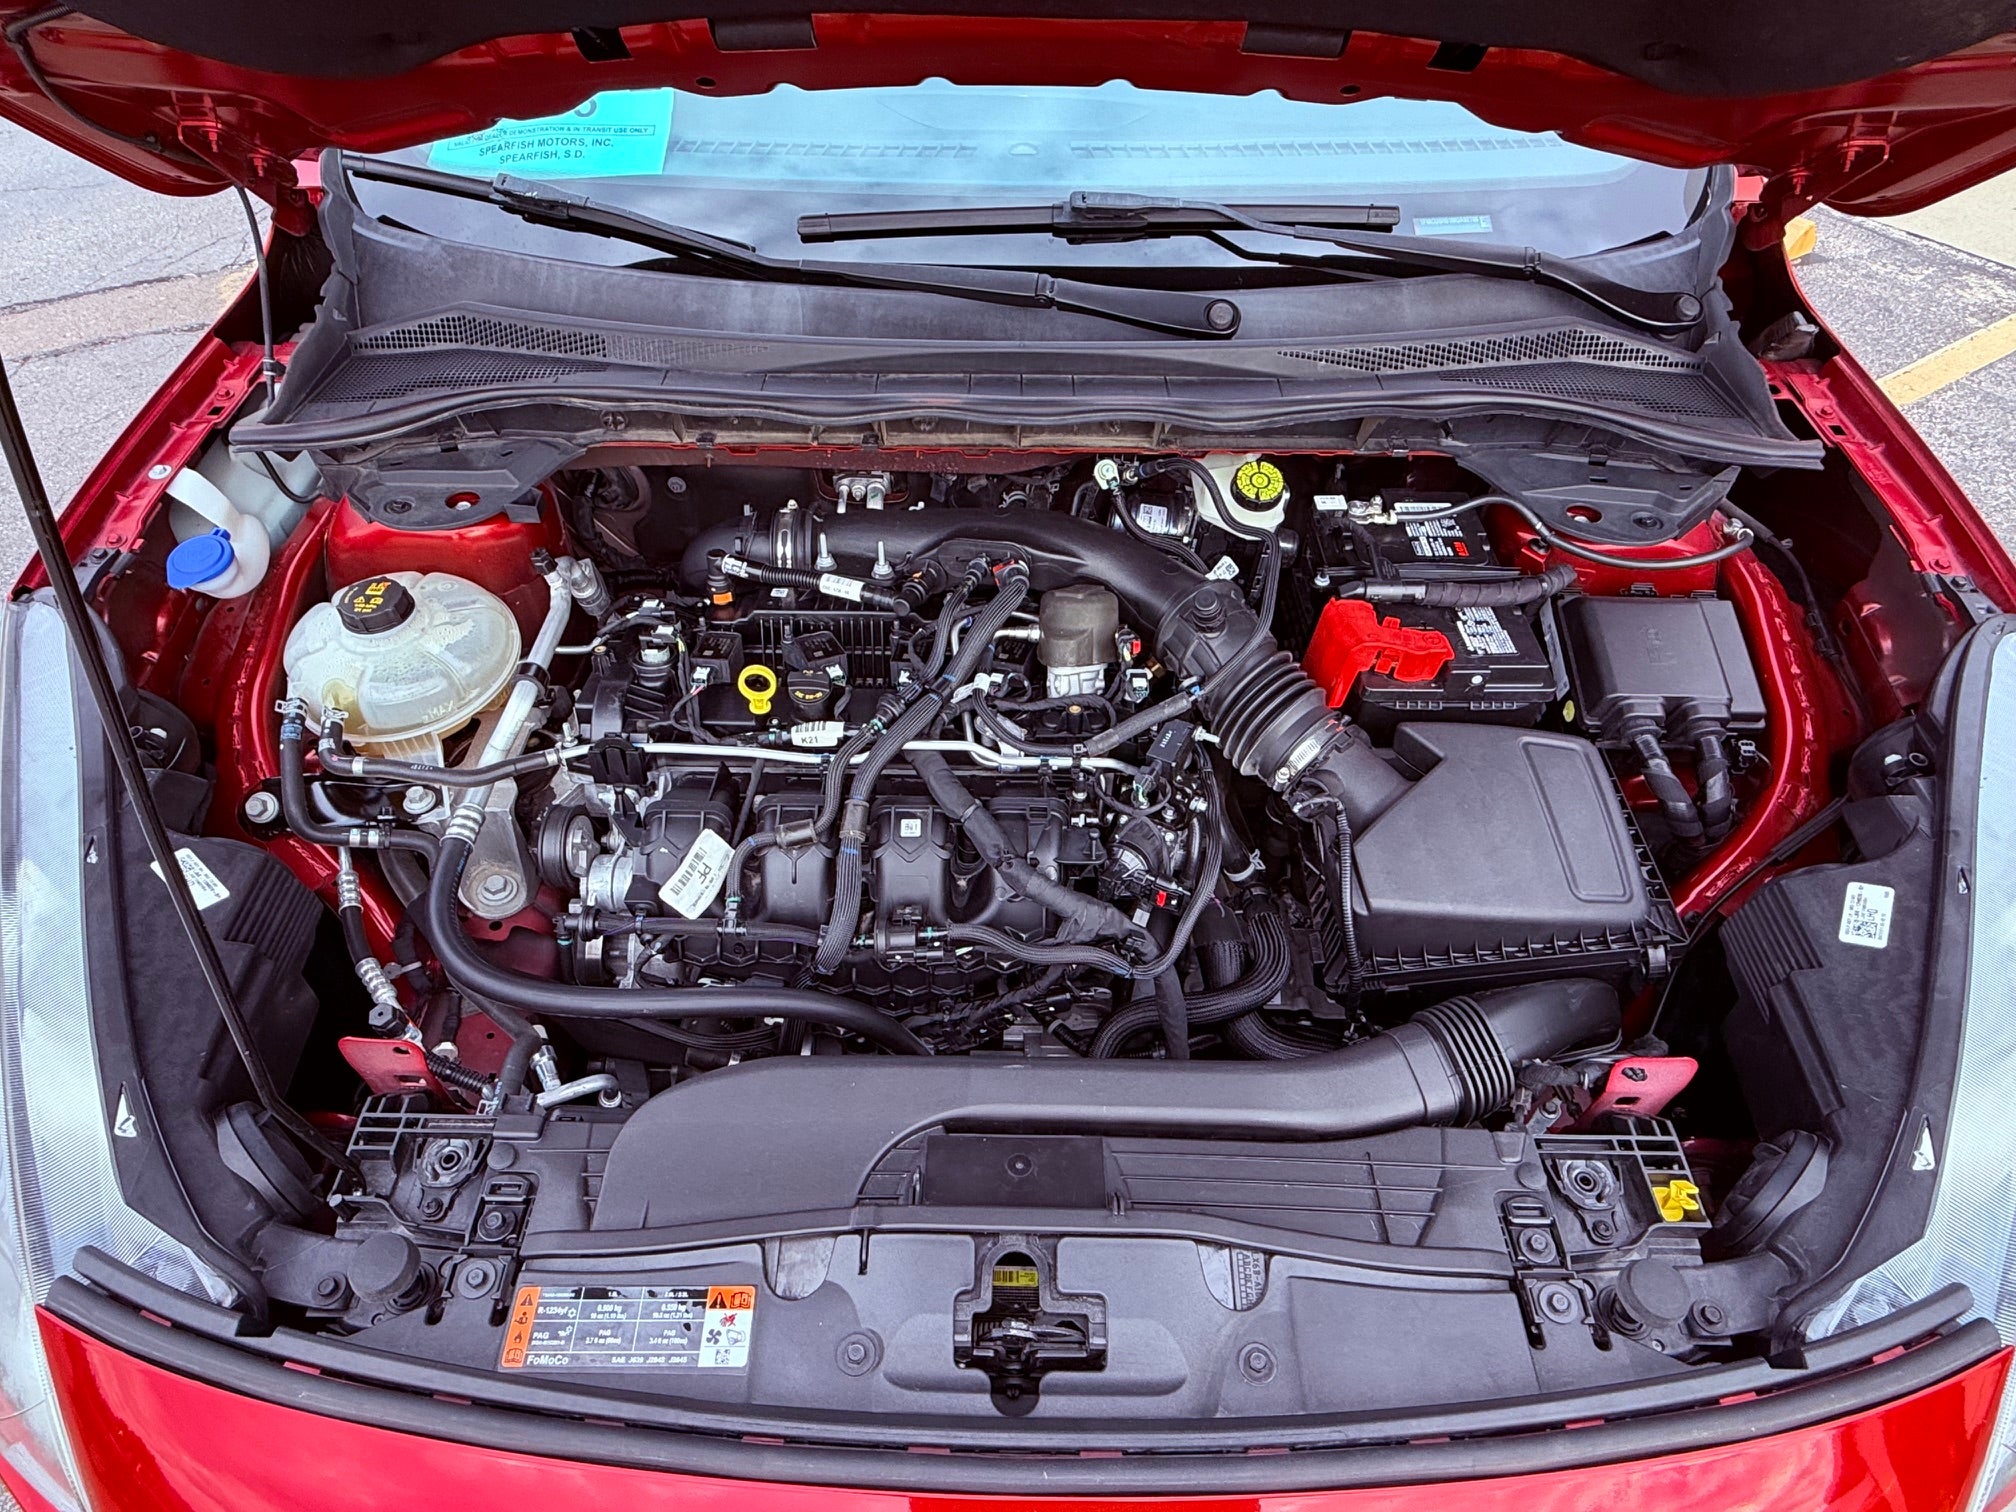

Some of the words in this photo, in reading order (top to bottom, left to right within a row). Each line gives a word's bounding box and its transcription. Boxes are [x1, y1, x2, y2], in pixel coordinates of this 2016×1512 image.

[479, 140, 534, 157] SPEARFISH
[537, 137, 588, 147] MOTORS,
[591, 138, 614, 147] INC.
[500, 150, 561, 165] SPEARFISH,
[801, 736, 819, 744] K21
[697, 862, 712, 885] PF
[526, 1355, 569, 1365] FoMoCo
